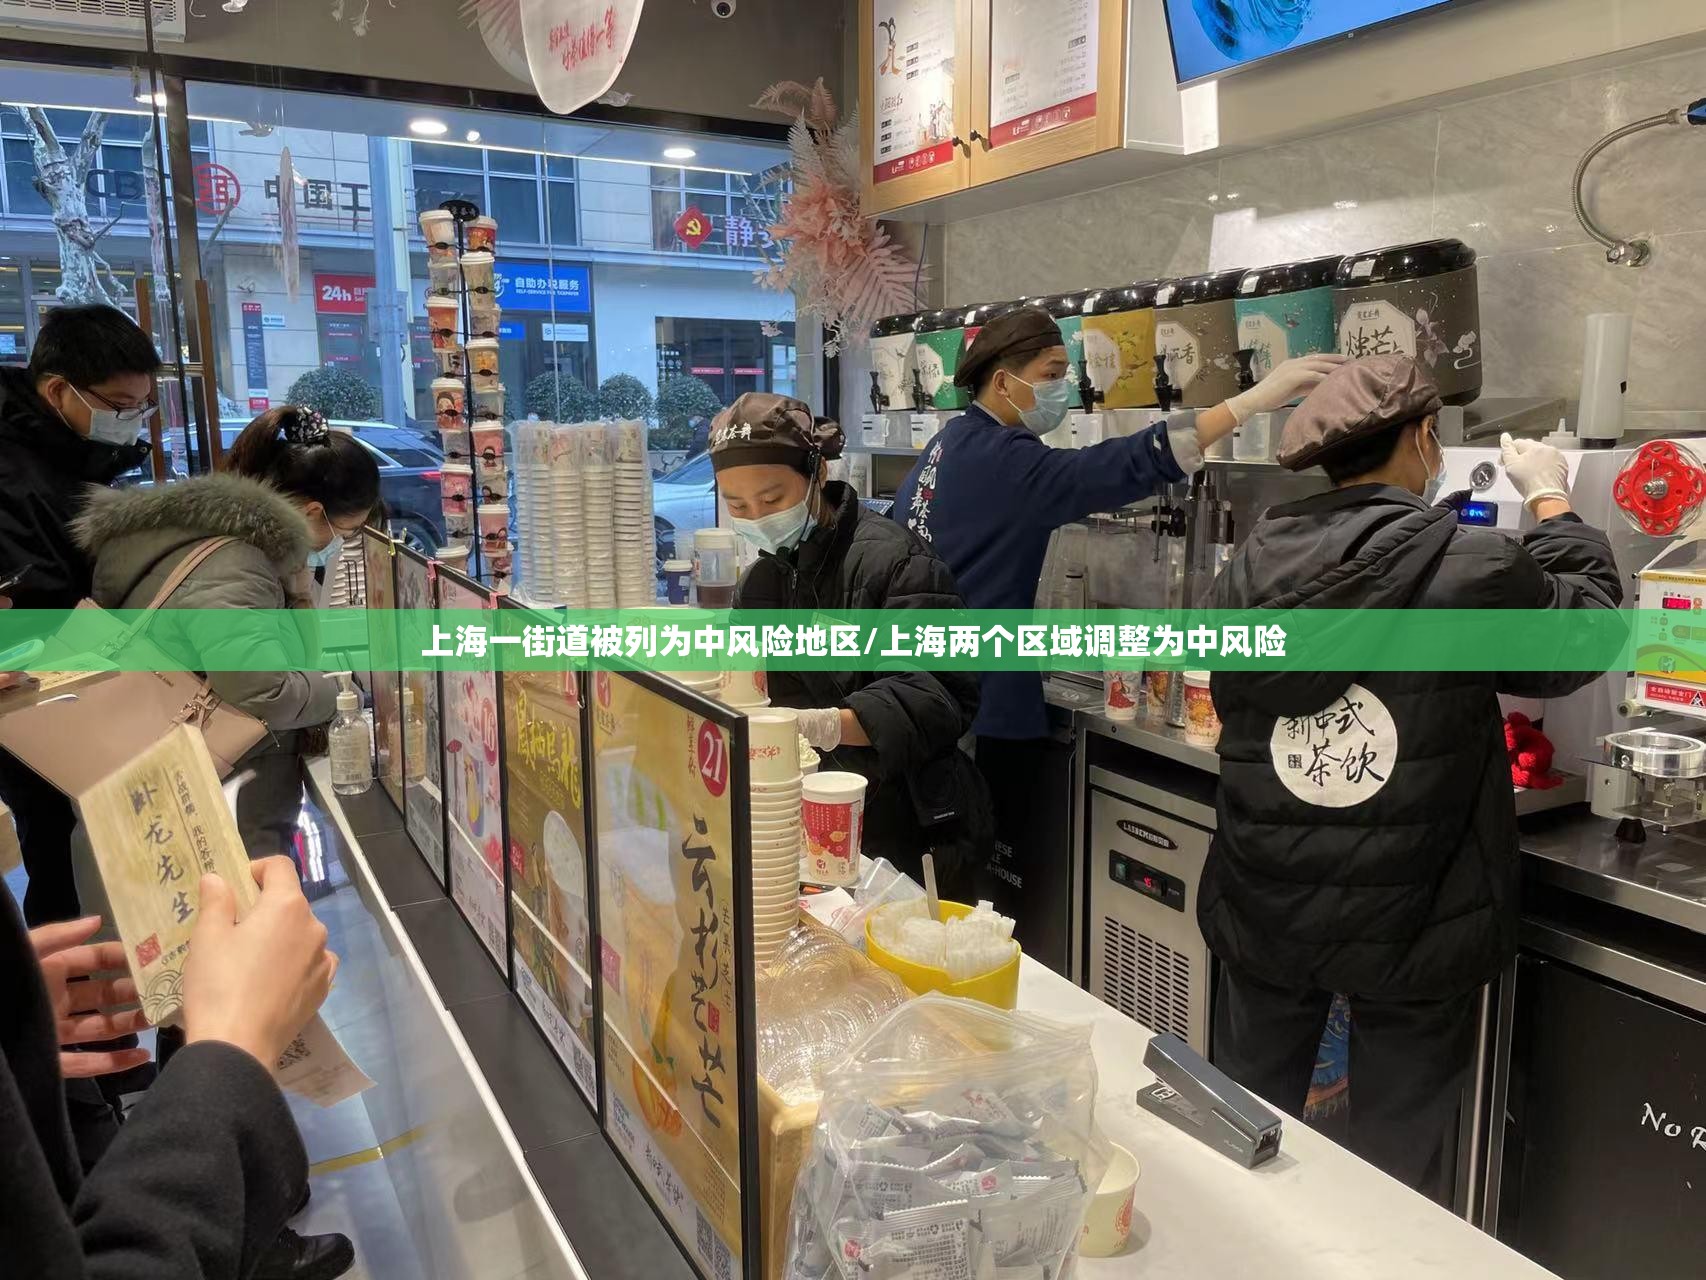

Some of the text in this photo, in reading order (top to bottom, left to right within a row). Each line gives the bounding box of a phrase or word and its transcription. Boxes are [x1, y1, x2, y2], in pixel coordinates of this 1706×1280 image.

[322, 285, 352, 302] 24h
[515, 277, 579, 291] 自助办税服务
[701, 730, 722, 785] 21
[1304, 738, 1385, 787] 茶饮
